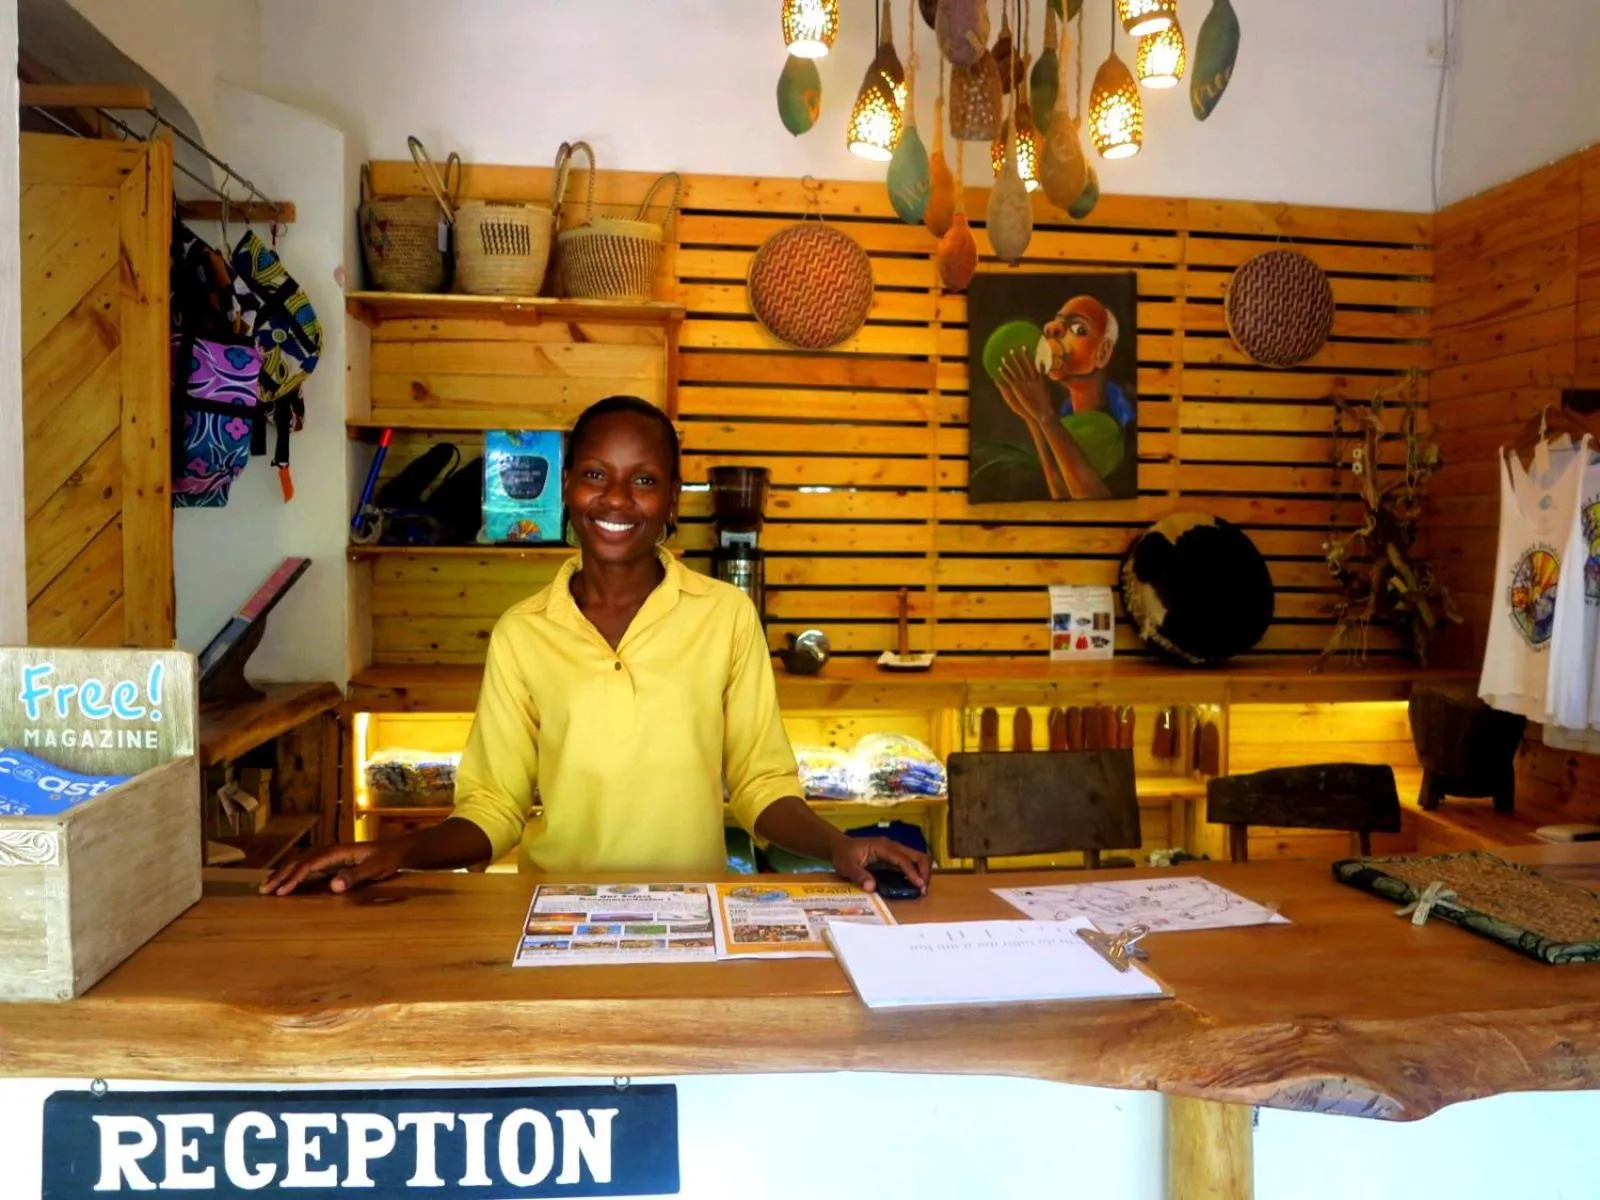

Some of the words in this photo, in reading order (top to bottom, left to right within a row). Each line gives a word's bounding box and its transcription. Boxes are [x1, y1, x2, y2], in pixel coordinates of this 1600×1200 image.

[19, 660, 163, 721] Free!
[24, 729, 158, 748] MAGAZINE
[92, 1108, 618, 1191] RECEPTION
